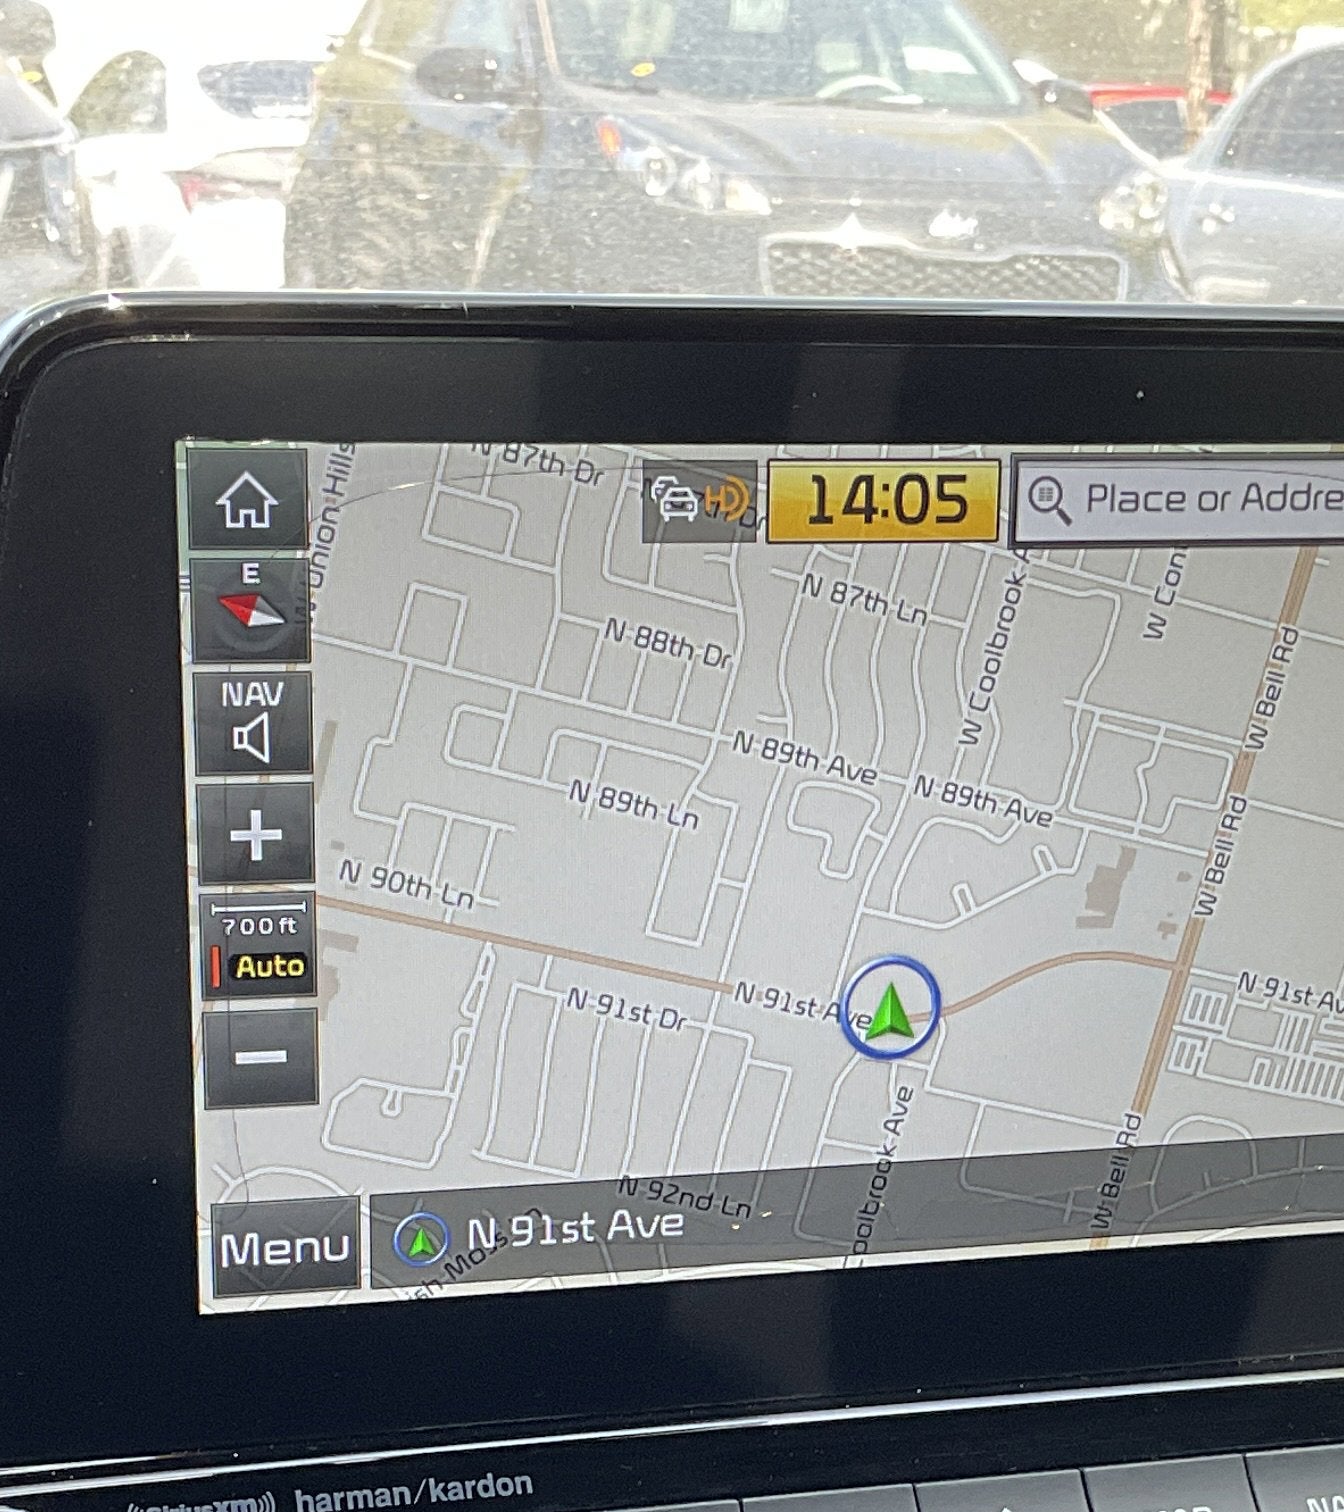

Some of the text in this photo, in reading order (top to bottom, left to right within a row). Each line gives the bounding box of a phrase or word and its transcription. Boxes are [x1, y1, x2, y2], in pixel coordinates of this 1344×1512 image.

[503, 442, 564, 476] 87th
[575, 459, 604, 486] Dr
[808, 474, 968, 526] 14:05
[1087, 483, 1186, 513] Place
[1198, 489, 1232, 511] or
[309, 506, 340, 589] Union
[242, 563, 260, 584] E
[1142, 546, 1189, 640] W Con
[801, 573, 928, 626] N 87th Ln
[604, 618, 732, 669] N 88th Dr
[969, 572, 1027, 712] Coolbrook
[222, 682, 284, 707] NAV
[1246, 626, 1300, 750] W Bell Rd
[732, 731, 878, 785] N 89th Ave
[958, 720, 982, 745] W
[570, 779, 699, 831] N 89th Ln
[913, 775, 1053, 828] N 89th Ave
[1194, 795, 1248, 917] W Bell Rd
[339, 859, 474, 910] N 90th Ln
[235, 955, 305, 979] Auto
[1237, 971, 1258, 993] N
[1264, 977, 1313, 1007] 91st
[567, 986, 688, 1031] N 91st Dr
[734, 981, 756, 1004] N
[763, 987, 817, 1018] 91st
[883, 1085, 914, 1137] Ave
[619, 1174, 752, 1220] N 92nd Ln
[1090, 1114, 1142, 1230] W Bell Rd
[221, 1233, 351, 1268] Menu
[468, 1218, 496, 1252] N
[511, 1209, 596, 1248] 91st
[608, 1207, 685, 1240] Ave
